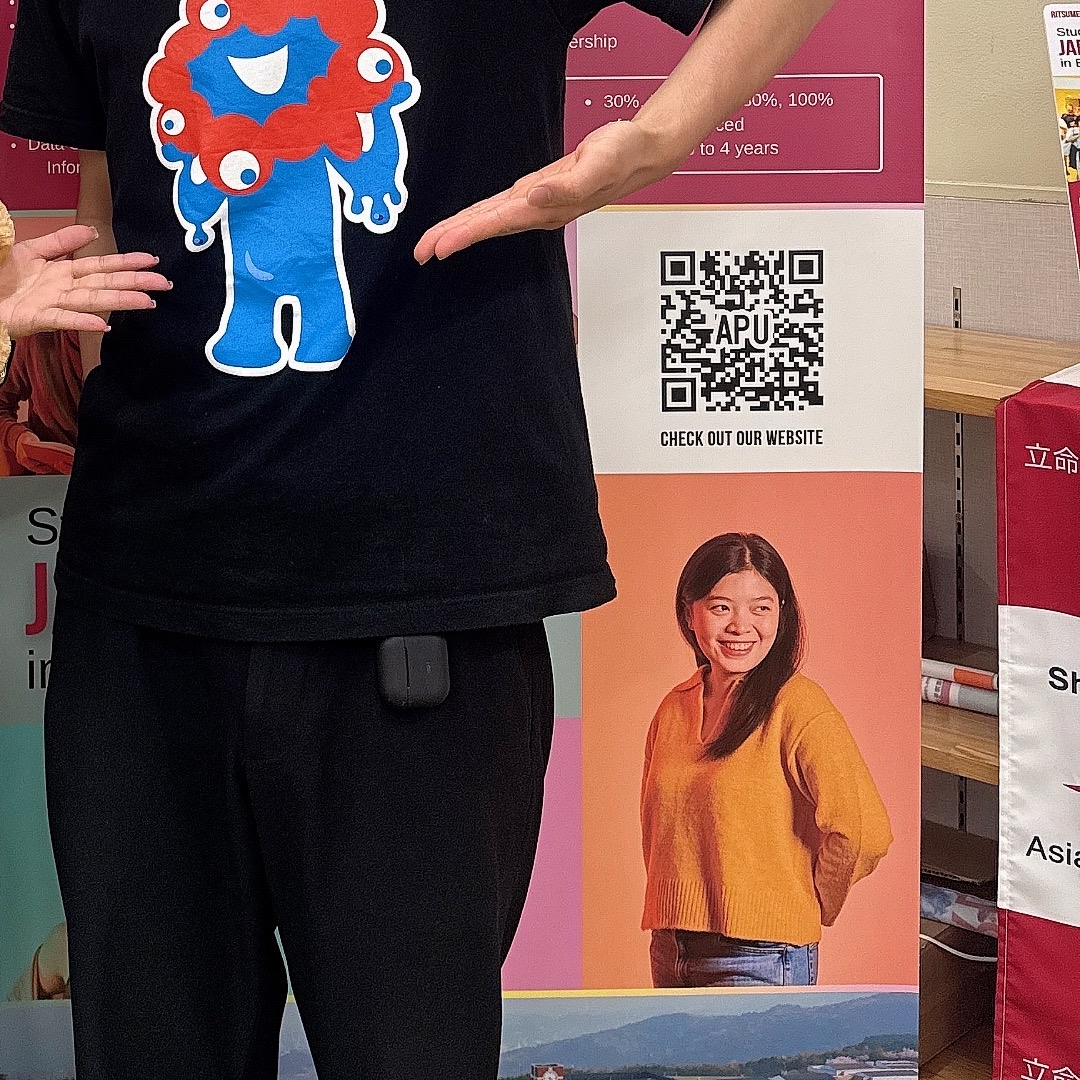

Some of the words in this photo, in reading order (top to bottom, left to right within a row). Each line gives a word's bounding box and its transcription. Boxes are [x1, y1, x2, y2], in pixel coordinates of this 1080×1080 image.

[1050, 10, 1080, 18] RITSUME
[568, 33, 618, 52] ership
[1059, 58, 1072, 68] in
[788, 92, 834, 108] 100%
[699, 142, 716, 156] to
[719, 141, 731, 156] 4
[734, 142, 779, 159] years
[47, 160, 81, 174] Infor
[715, 314, 769, 345] APU
[660, 430, 704, 447] CHECK
[707, 430, 733, 447] OUT
[736, 430, 762, 446] OUR
[766, 429, 824, 446] WEBSITE
